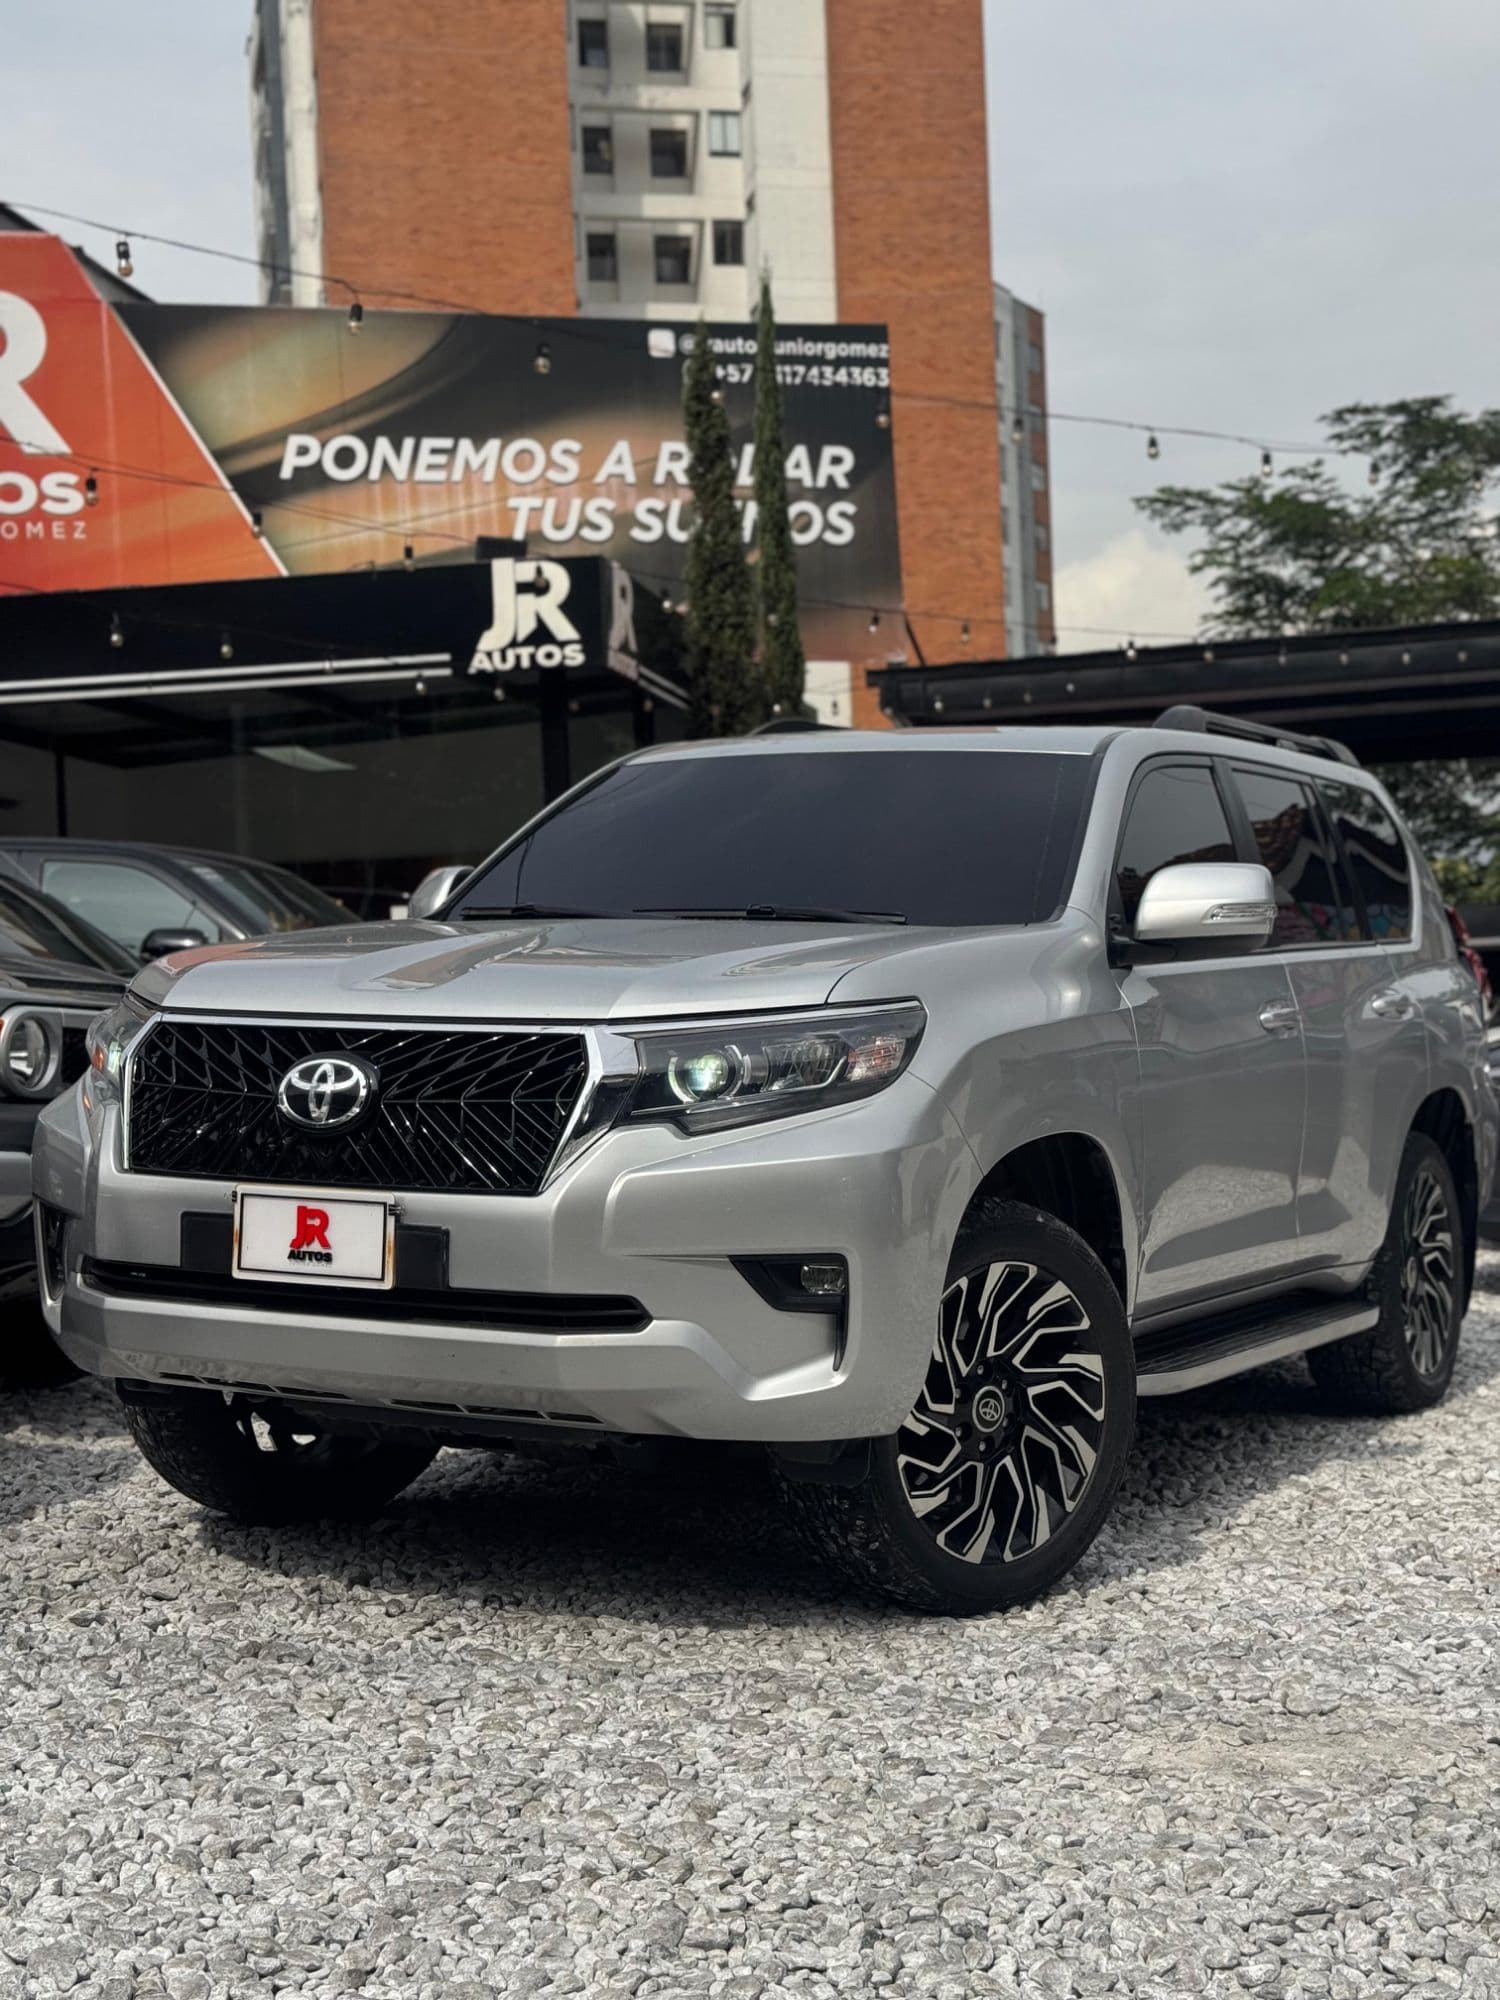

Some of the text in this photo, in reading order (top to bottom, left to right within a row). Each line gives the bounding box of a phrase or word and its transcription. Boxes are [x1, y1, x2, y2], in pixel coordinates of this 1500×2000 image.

[768, 363, 890, 388] 117434363
[279, 434, 581, 484] PONEMOS
[595, 439, 637, 485] A
[506, 496, 858, 546] TUS SUOS
[476, 557, 582, 652] JR
[467, 643, 586, 675] AUTOS
[289, 1205, 332, 1250] JR
[287, 1248, 333, 1264] AUTOS
